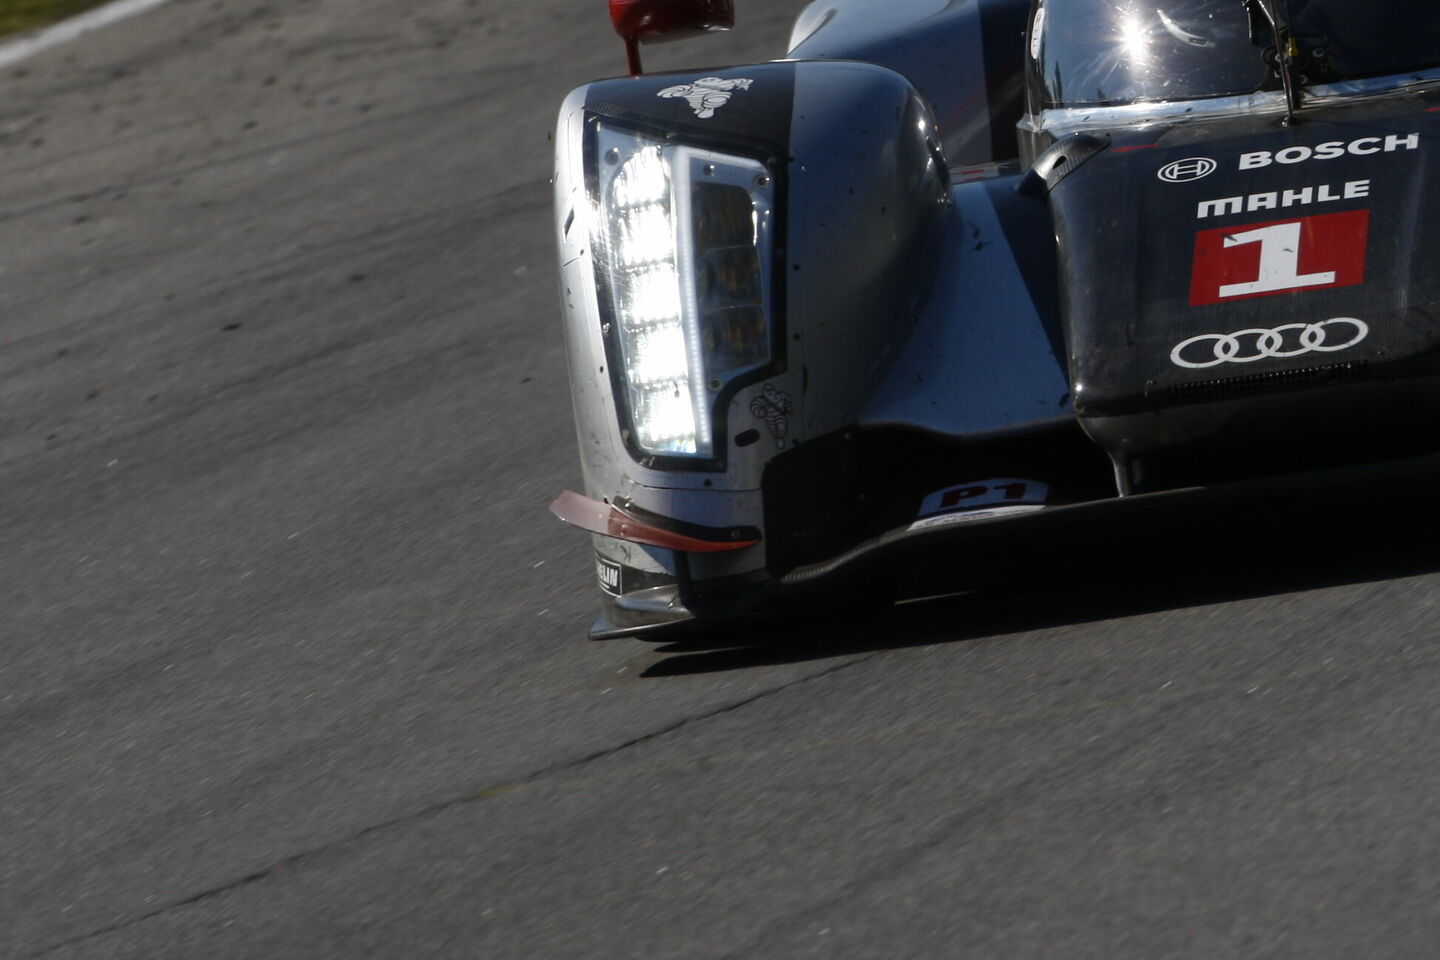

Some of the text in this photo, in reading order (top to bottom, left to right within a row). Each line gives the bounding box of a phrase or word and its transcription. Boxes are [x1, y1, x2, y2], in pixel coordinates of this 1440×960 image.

[1238, 132, 1420, 171] BOSCH
[1196, 179, 1371, 219] MAHLE
[1218, 221, 1337, 298] 1
[940, 483, 1027, 509] P1
